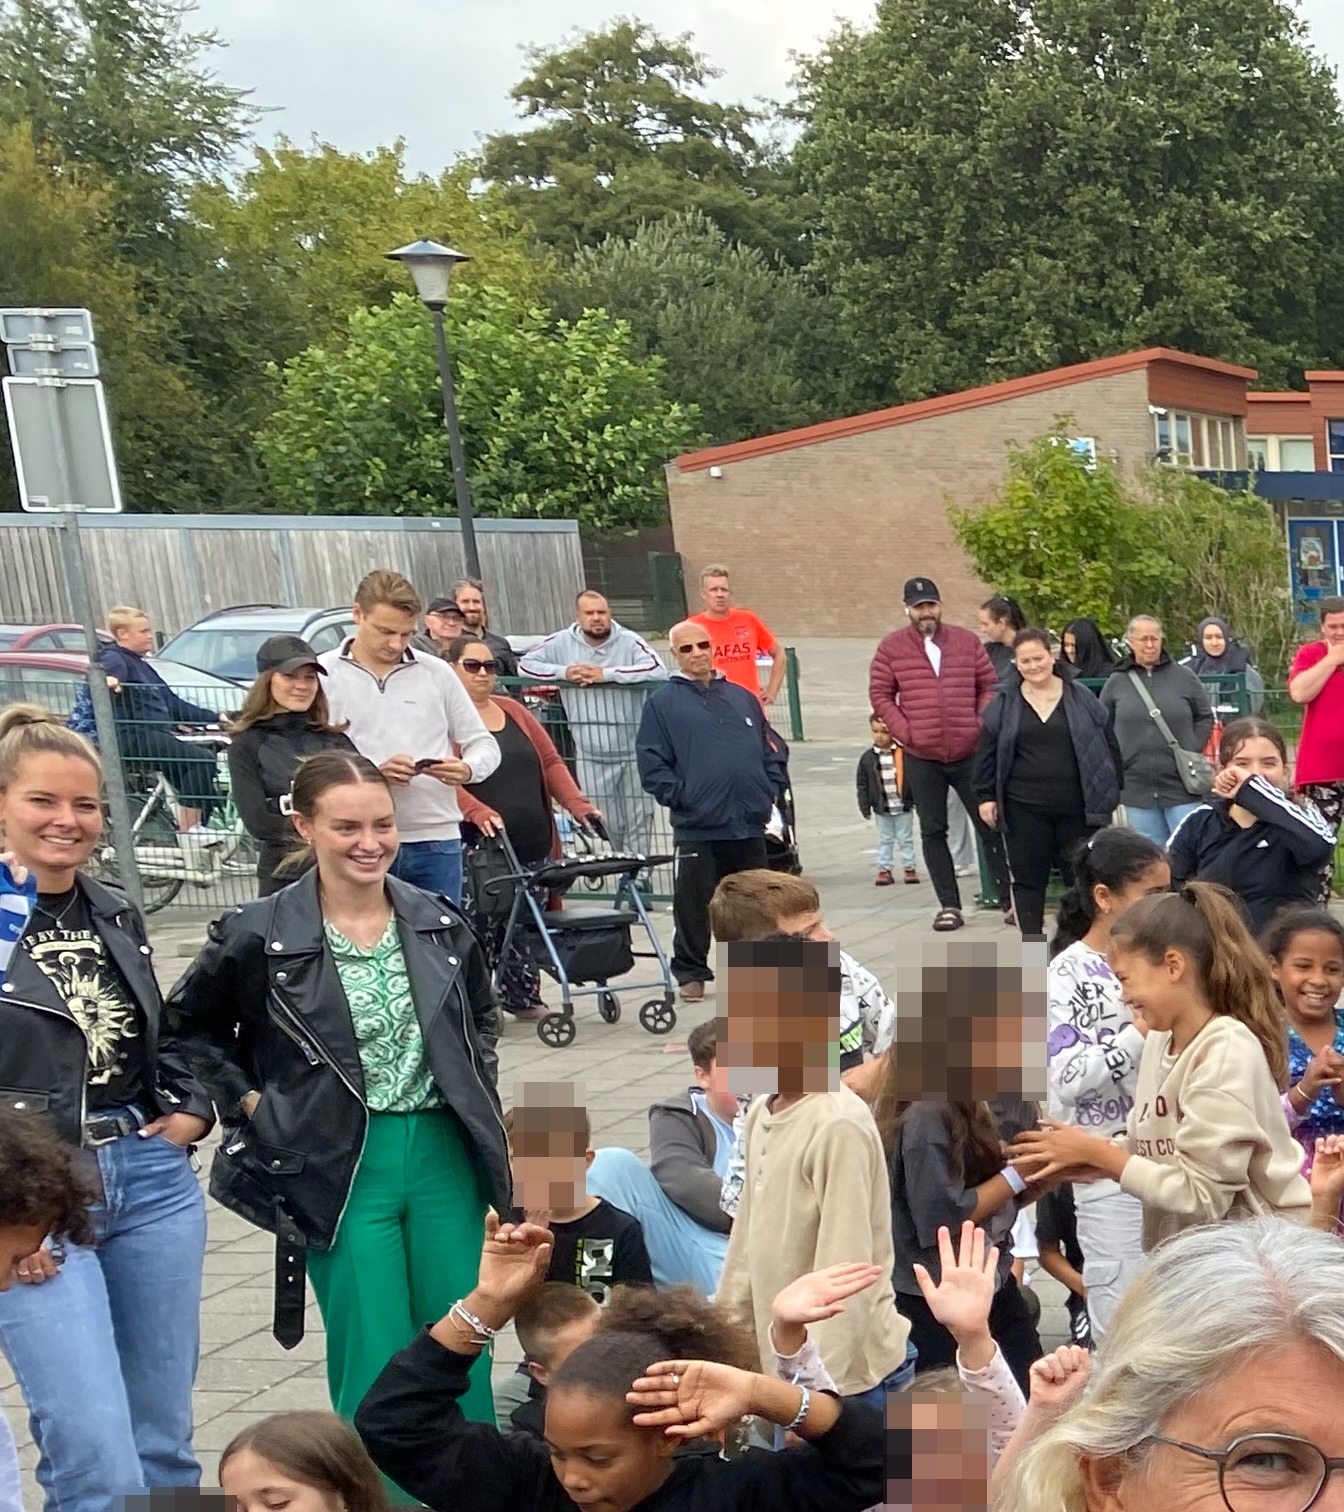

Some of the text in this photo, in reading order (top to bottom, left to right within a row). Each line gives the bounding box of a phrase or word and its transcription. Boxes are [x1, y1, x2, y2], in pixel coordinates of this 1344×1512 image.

[713, 643, 751, 659] AFAS
[37, 931, 55, 943] BY
[59, 929, 91, 941] THE
